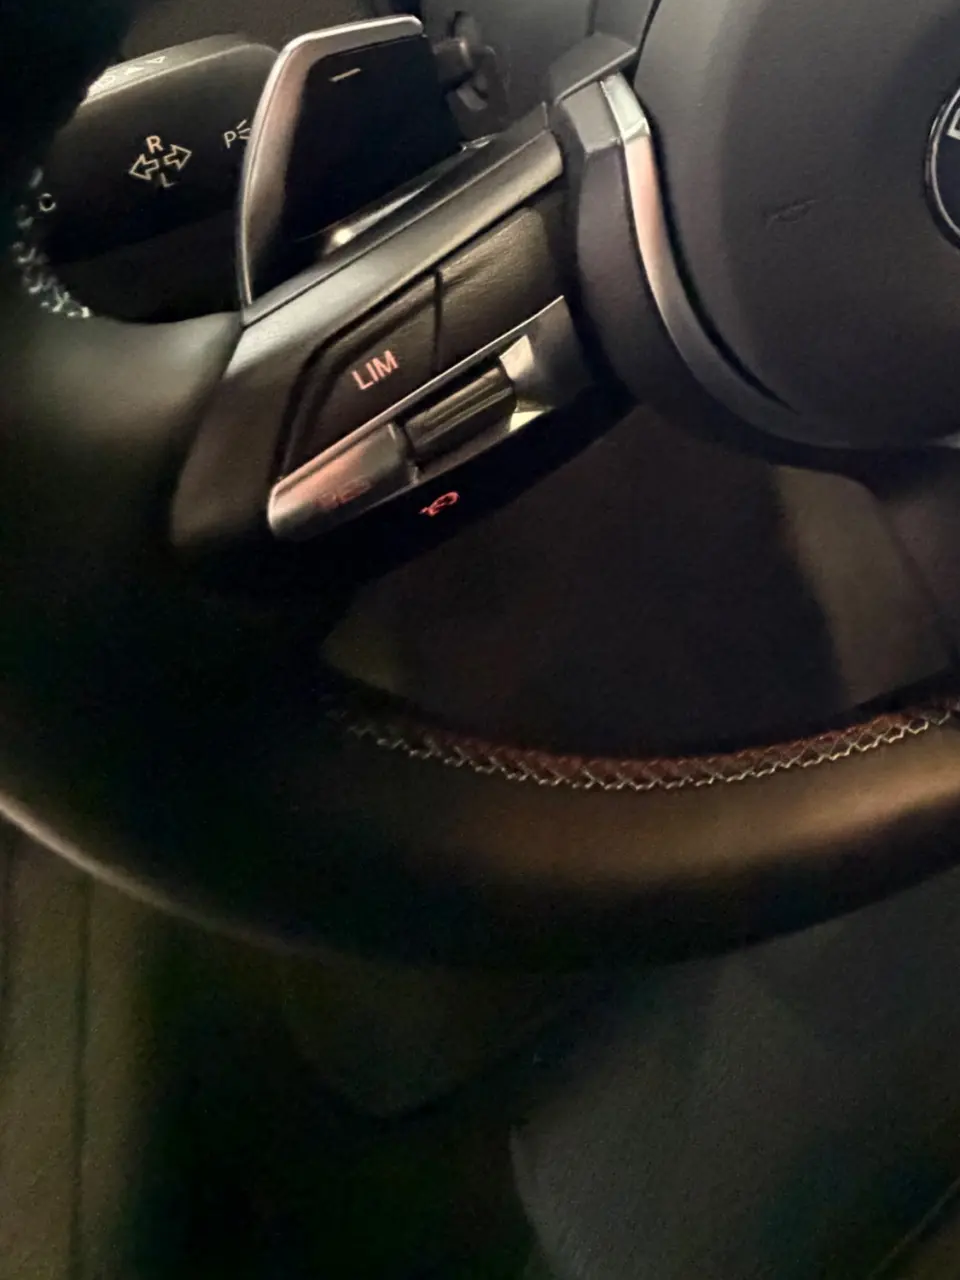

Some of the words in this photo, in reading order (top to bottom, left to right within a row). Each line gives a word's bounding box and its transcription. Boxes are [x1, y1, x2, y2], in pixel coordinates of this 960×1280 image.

[146, 135, 164, 154] R
[223, 130, 238, 149] P
[160, 172, 175, 188] L
[351, 350, 398, 390] LIM
